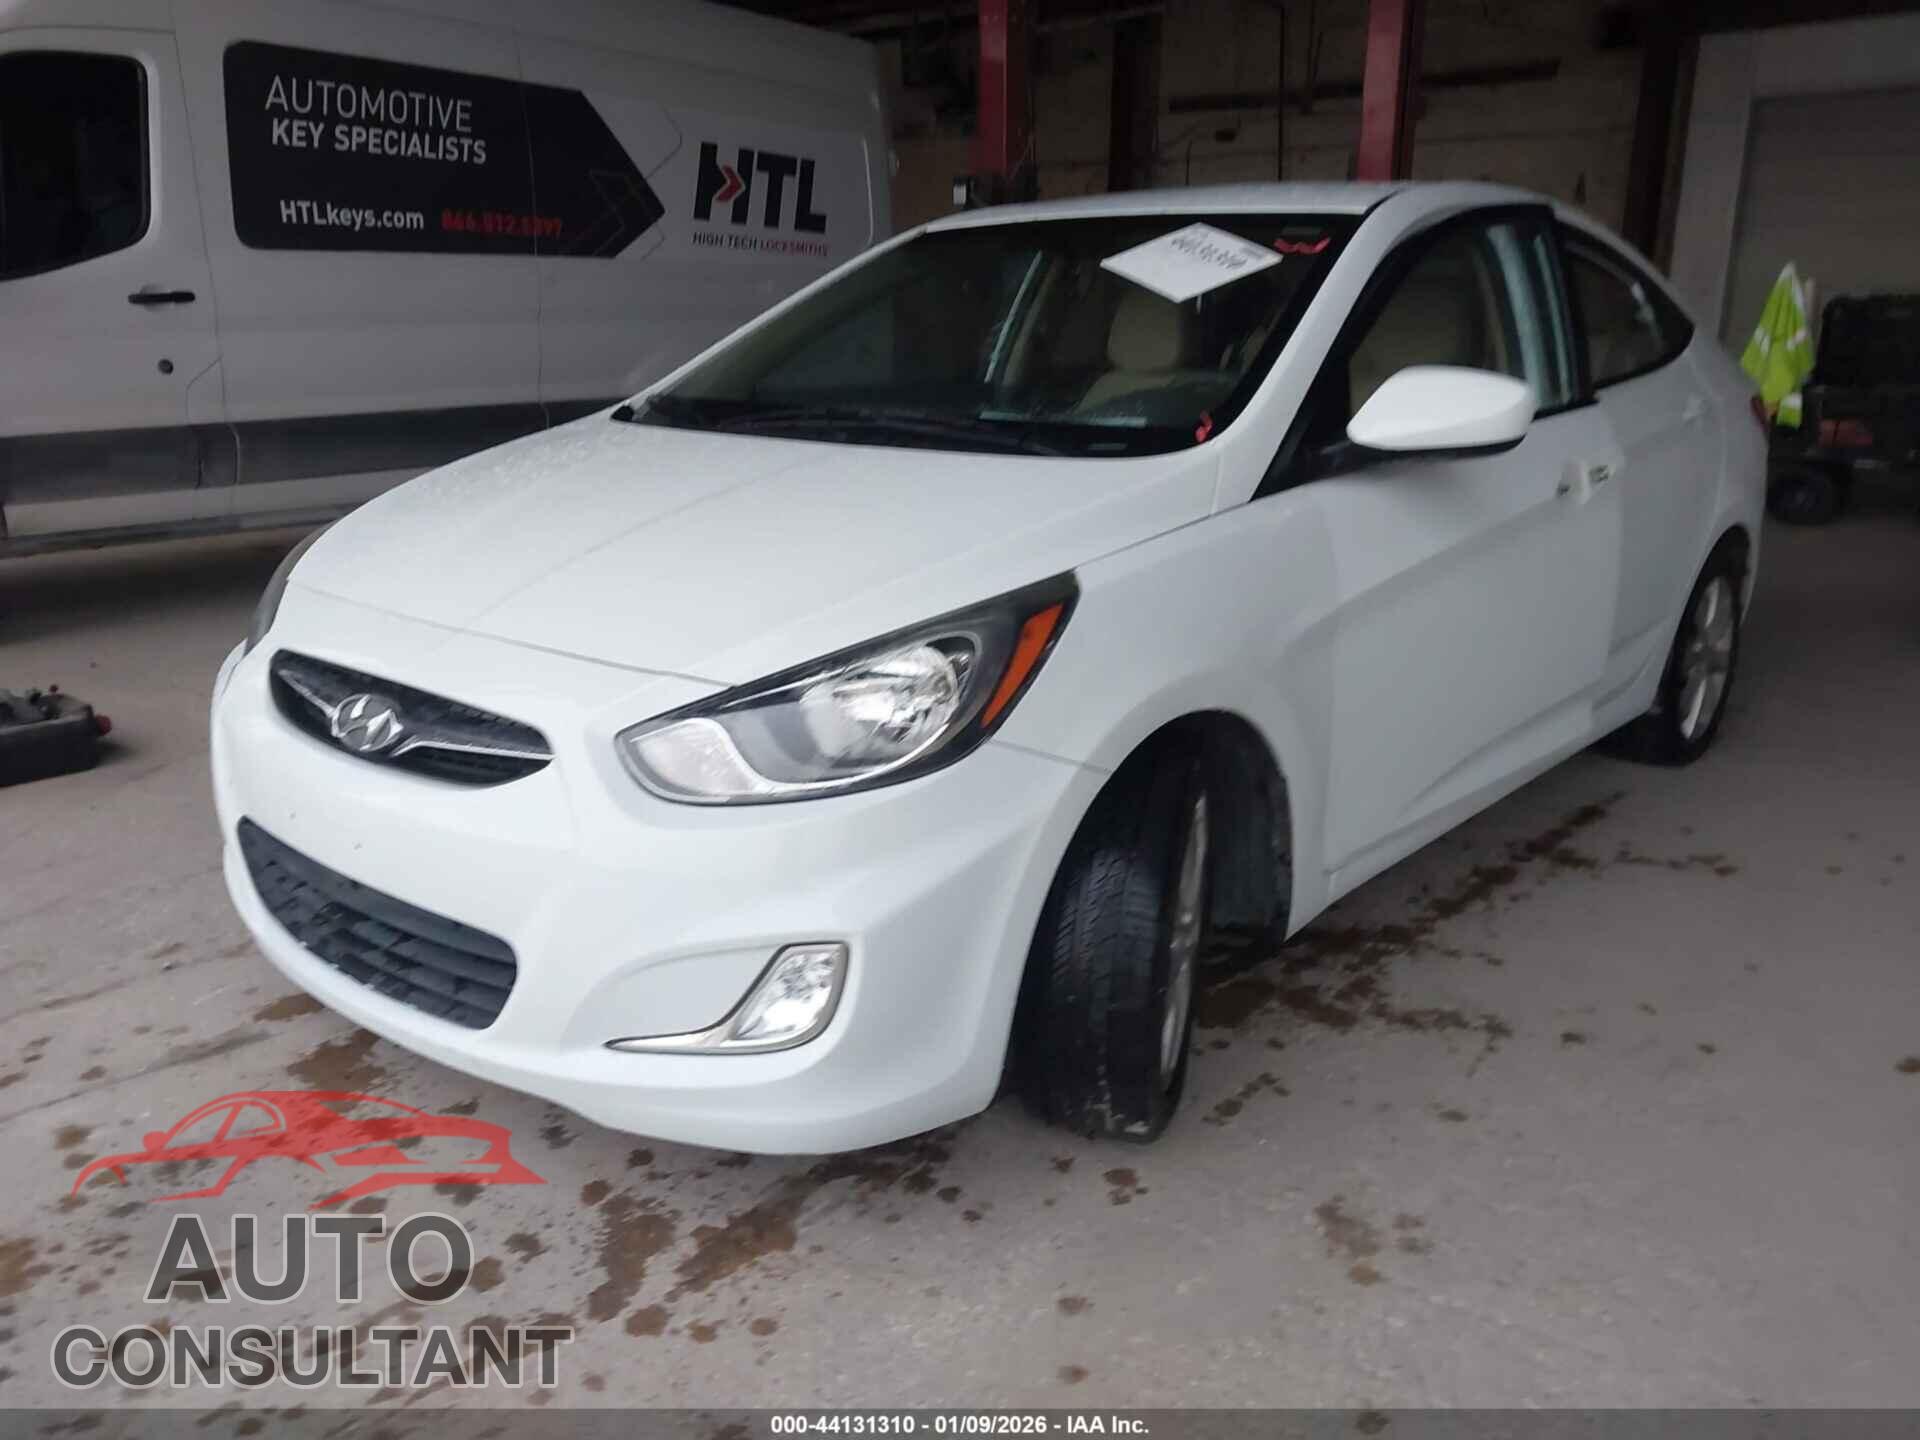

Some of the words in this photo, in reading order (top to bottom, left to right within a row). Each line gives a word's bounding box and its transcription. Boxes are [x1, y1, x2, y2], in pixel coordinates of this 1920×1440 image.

[264, 75, 473, 133] AUTOMOTIVE
[271, 118, 325, 148] KEY
[334, 125, 488, 165] SPECIALISTS
[693, 141, 827, 235] HTL
[279, 200, 425, 232] HTLkeys.com
[691, 231, 725, 247] HIGH
[726, 234, 758, 250] TECH
